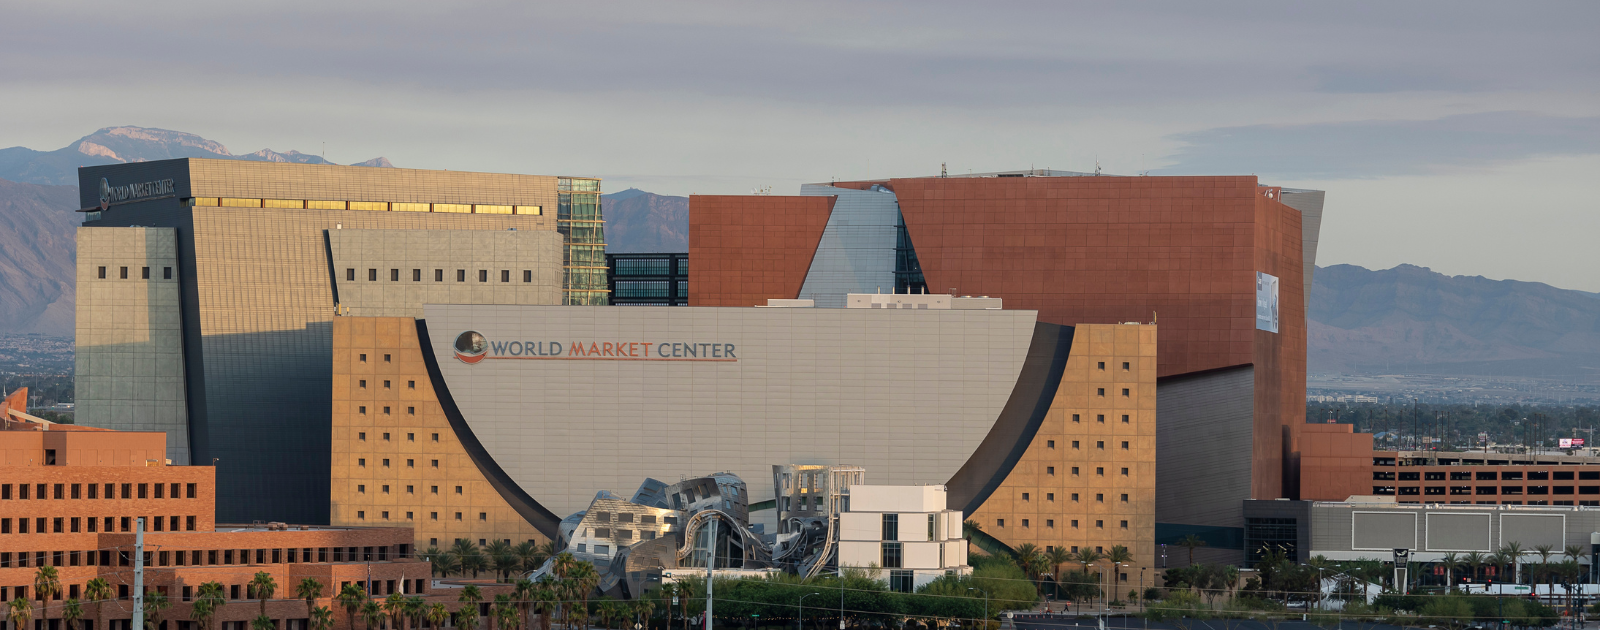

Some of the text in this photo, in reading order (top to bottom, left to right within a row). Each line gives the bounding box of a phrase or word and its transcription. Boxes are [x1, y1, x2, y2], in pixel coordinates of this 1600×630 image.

[109, 179, 174, 202] WORLD MARKET CENTER
[491, 341, 737, 358] WORLD MARKET CENTER
